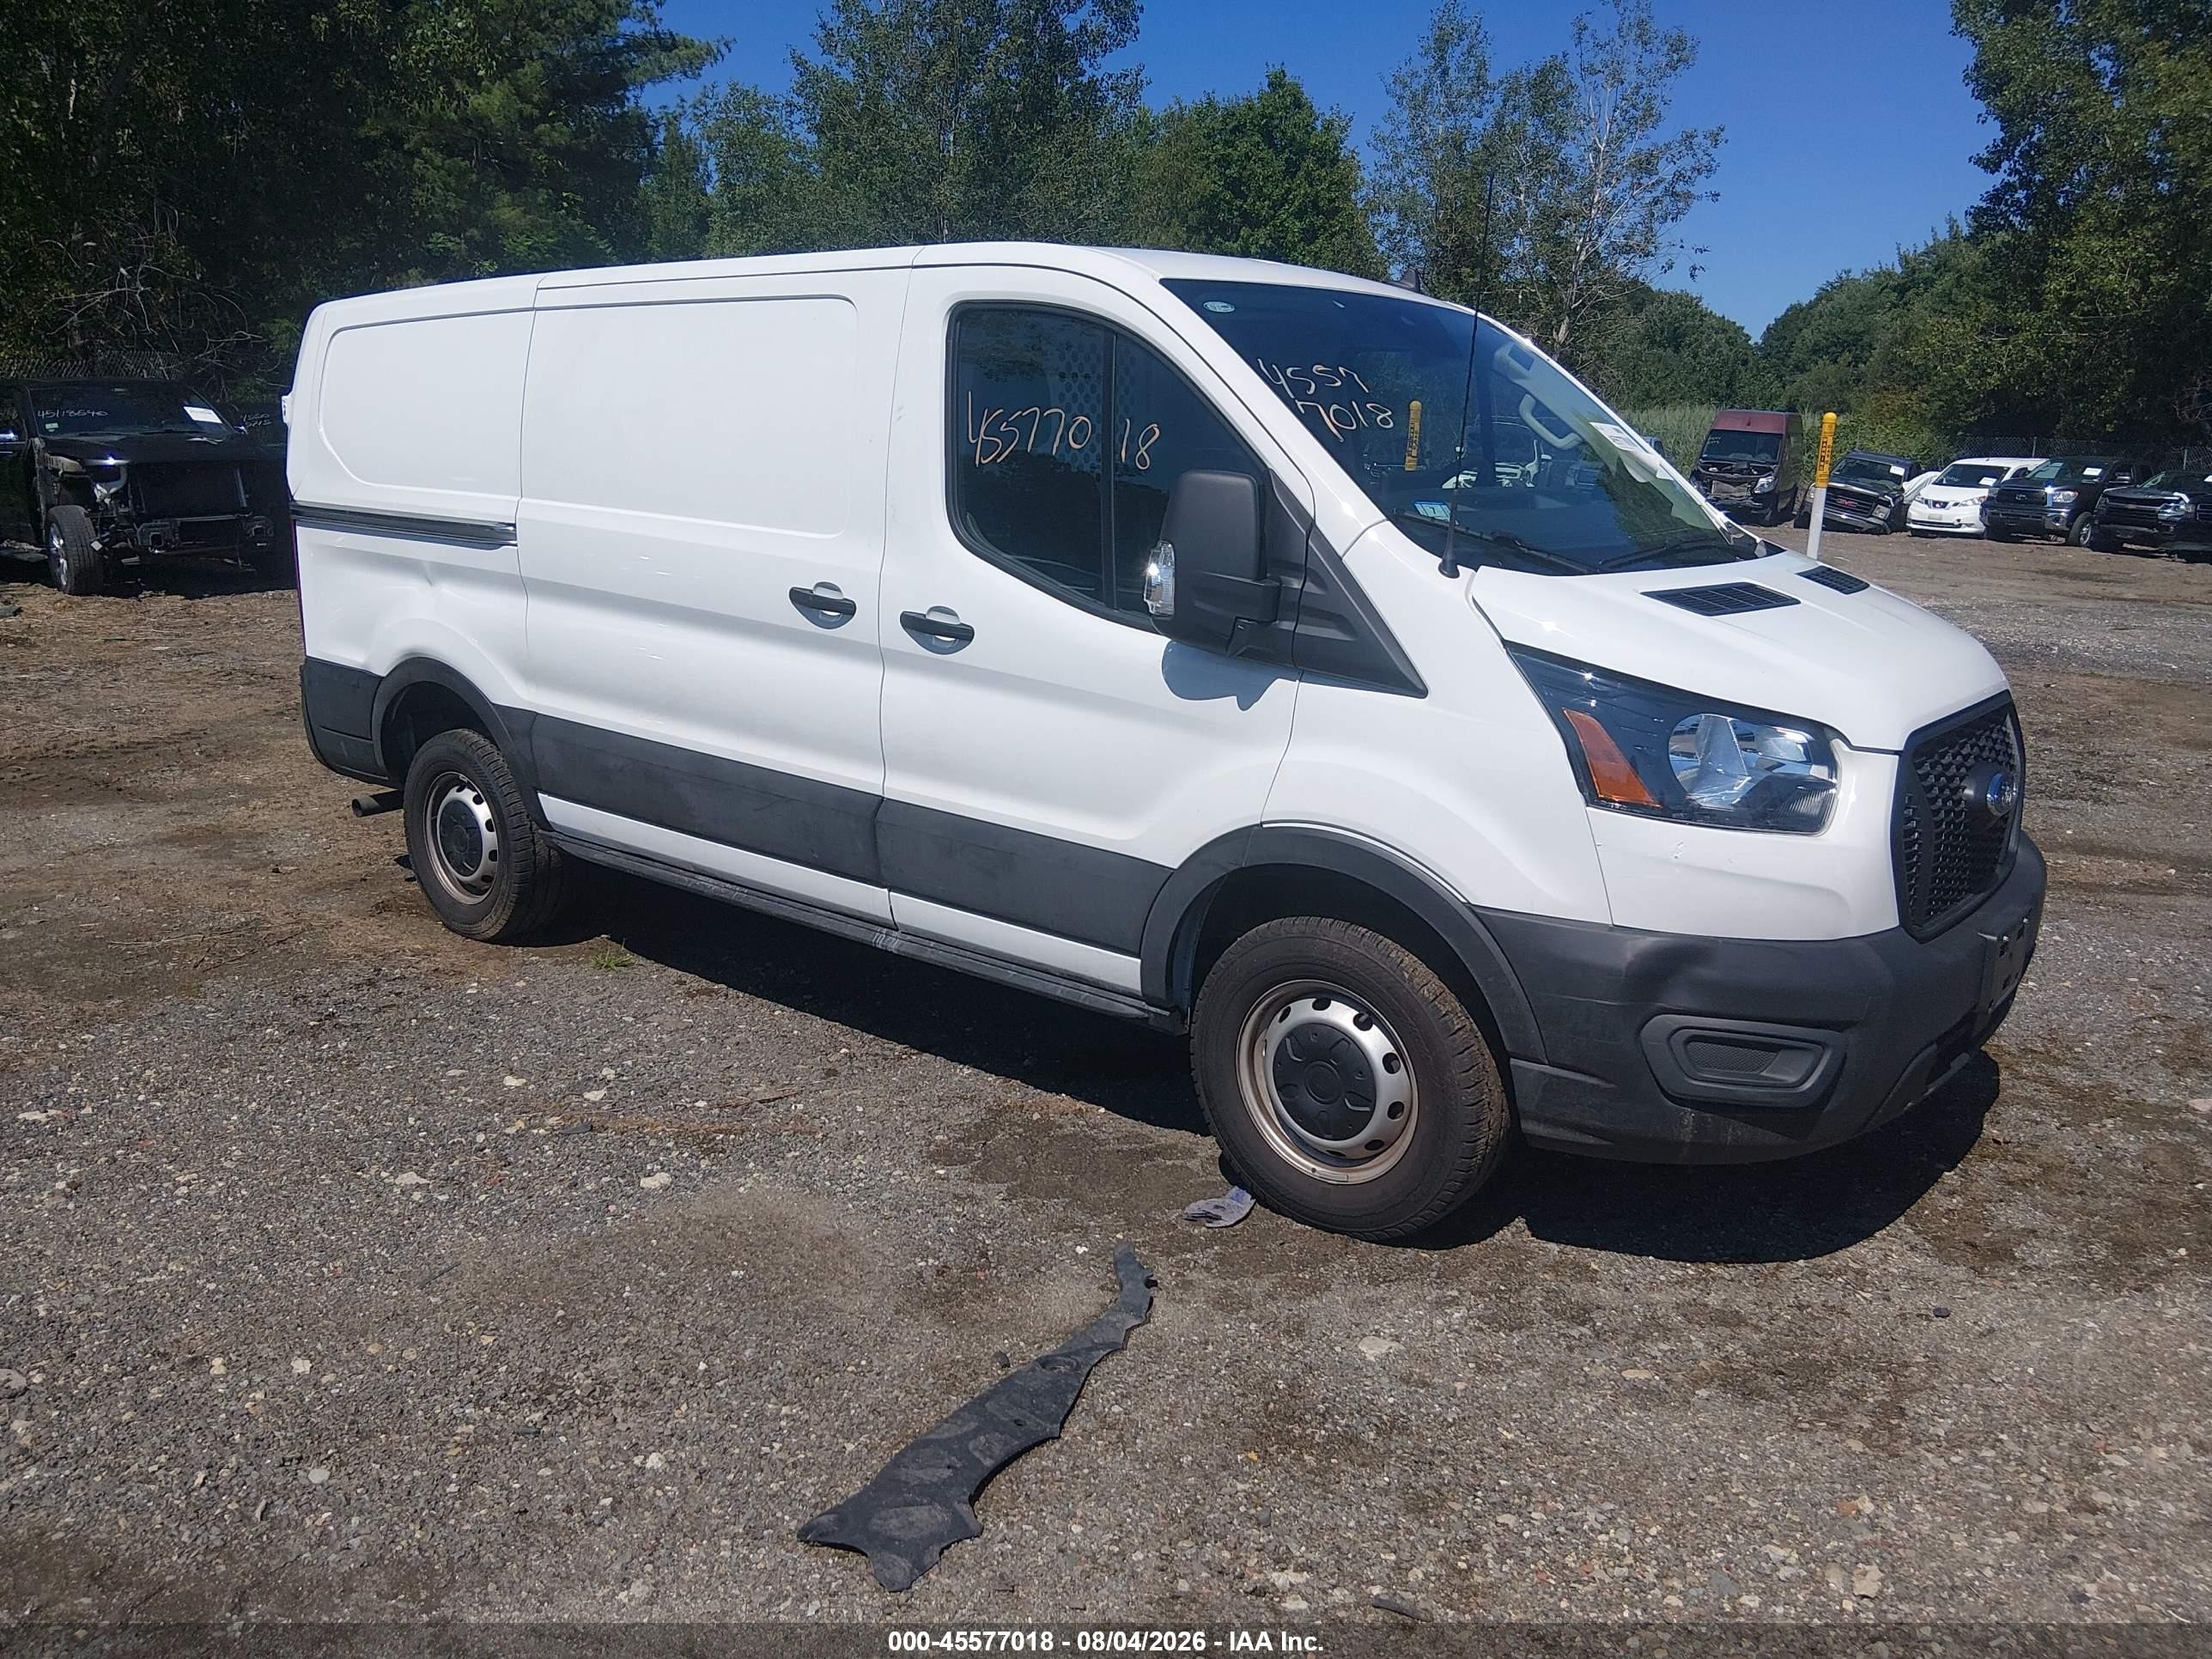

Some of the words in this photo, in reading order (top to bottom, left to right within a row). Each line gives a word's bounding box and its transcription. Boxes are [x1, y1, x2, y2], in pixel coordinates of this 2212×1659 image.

[1257, 358, 1370, 399] 4557
[1295, 399, 1395, 443] 7018
[1120, 417, 1161, 471] 18
